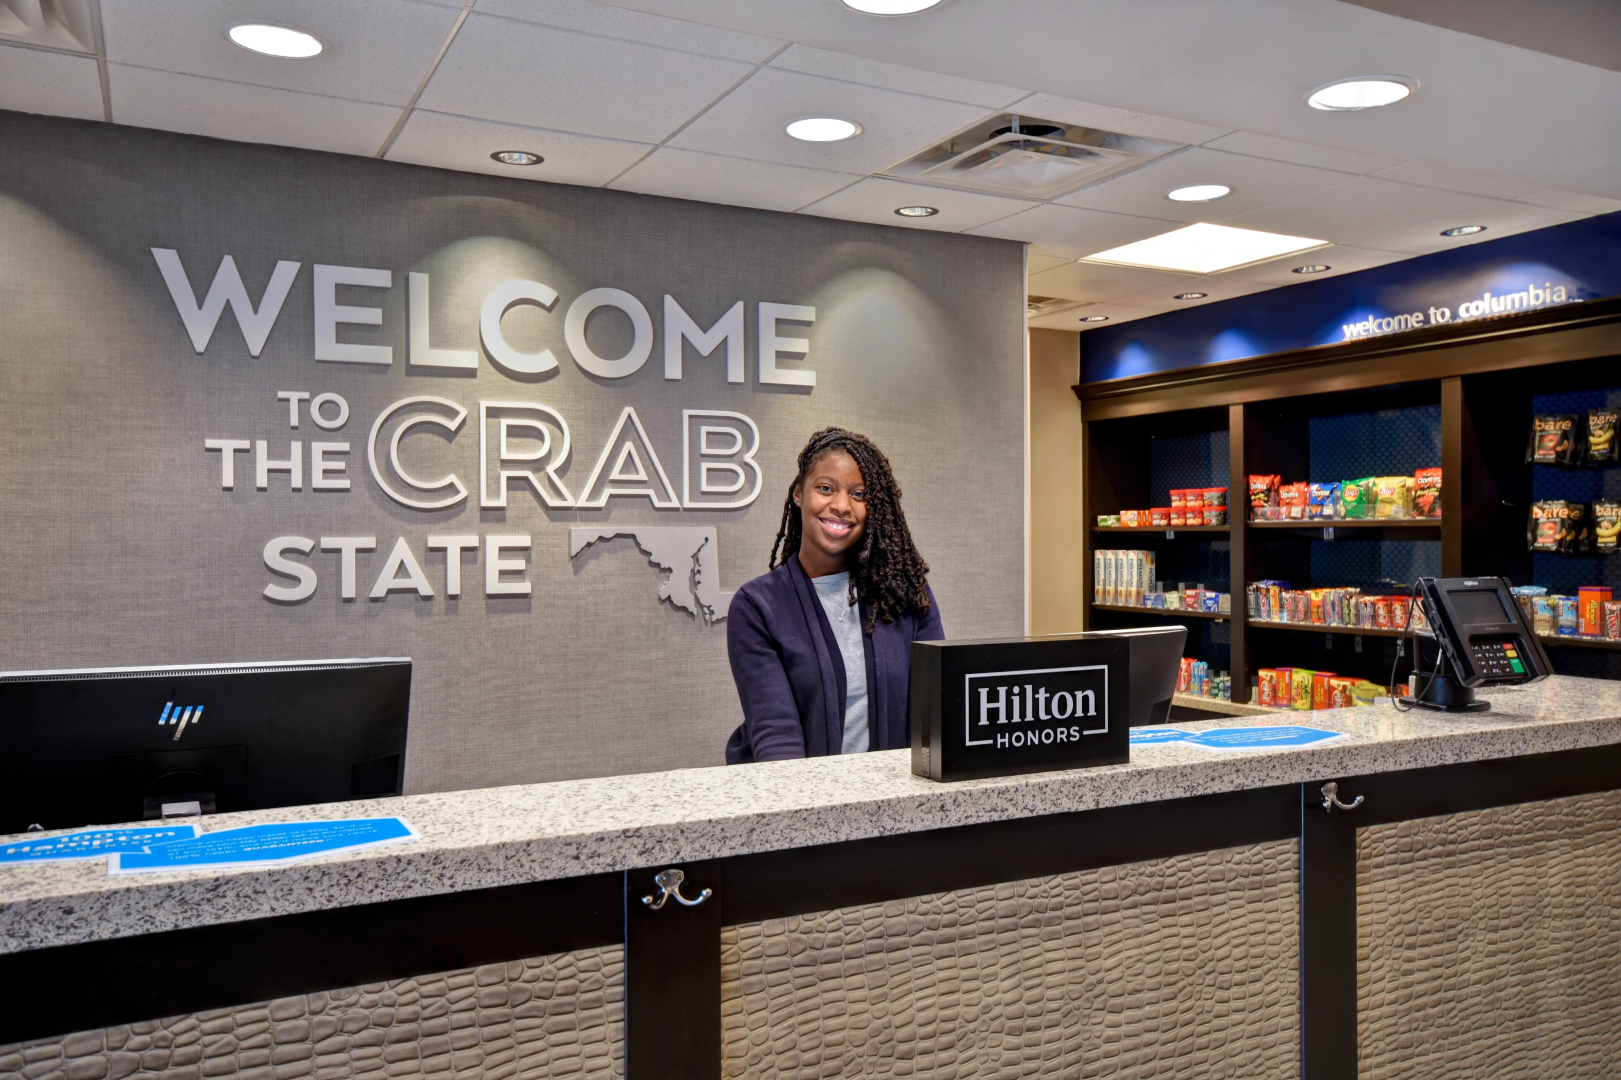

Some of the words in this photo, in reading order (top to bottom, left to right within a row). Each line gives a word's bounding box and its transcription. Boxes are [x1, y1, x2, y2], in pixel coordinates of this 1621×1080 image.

[151, 247, 817, 387] WELCOME
[1342, 312, 1424, 339] welcome
[1428, 306, 1451, 325] to
[1458, 282, 1568, 318] columbia
[277, 391, 350, 430] TO
[1535, 418, 1572, 430] bare
[1589, 414, 1618, 425] bare
[204, 438, 351, 490] THE
[367, 396, 763, 510] CRAB
[1533, 505, 1569, 519] bare
[262, 535, 532, 603] STATE
[157, 700, 204, 741] hp
[978, 684, 1097, 725] Hilton
[997, 726, 1080, 749] HONORS
[6, 832, 176, 855] Hampton
